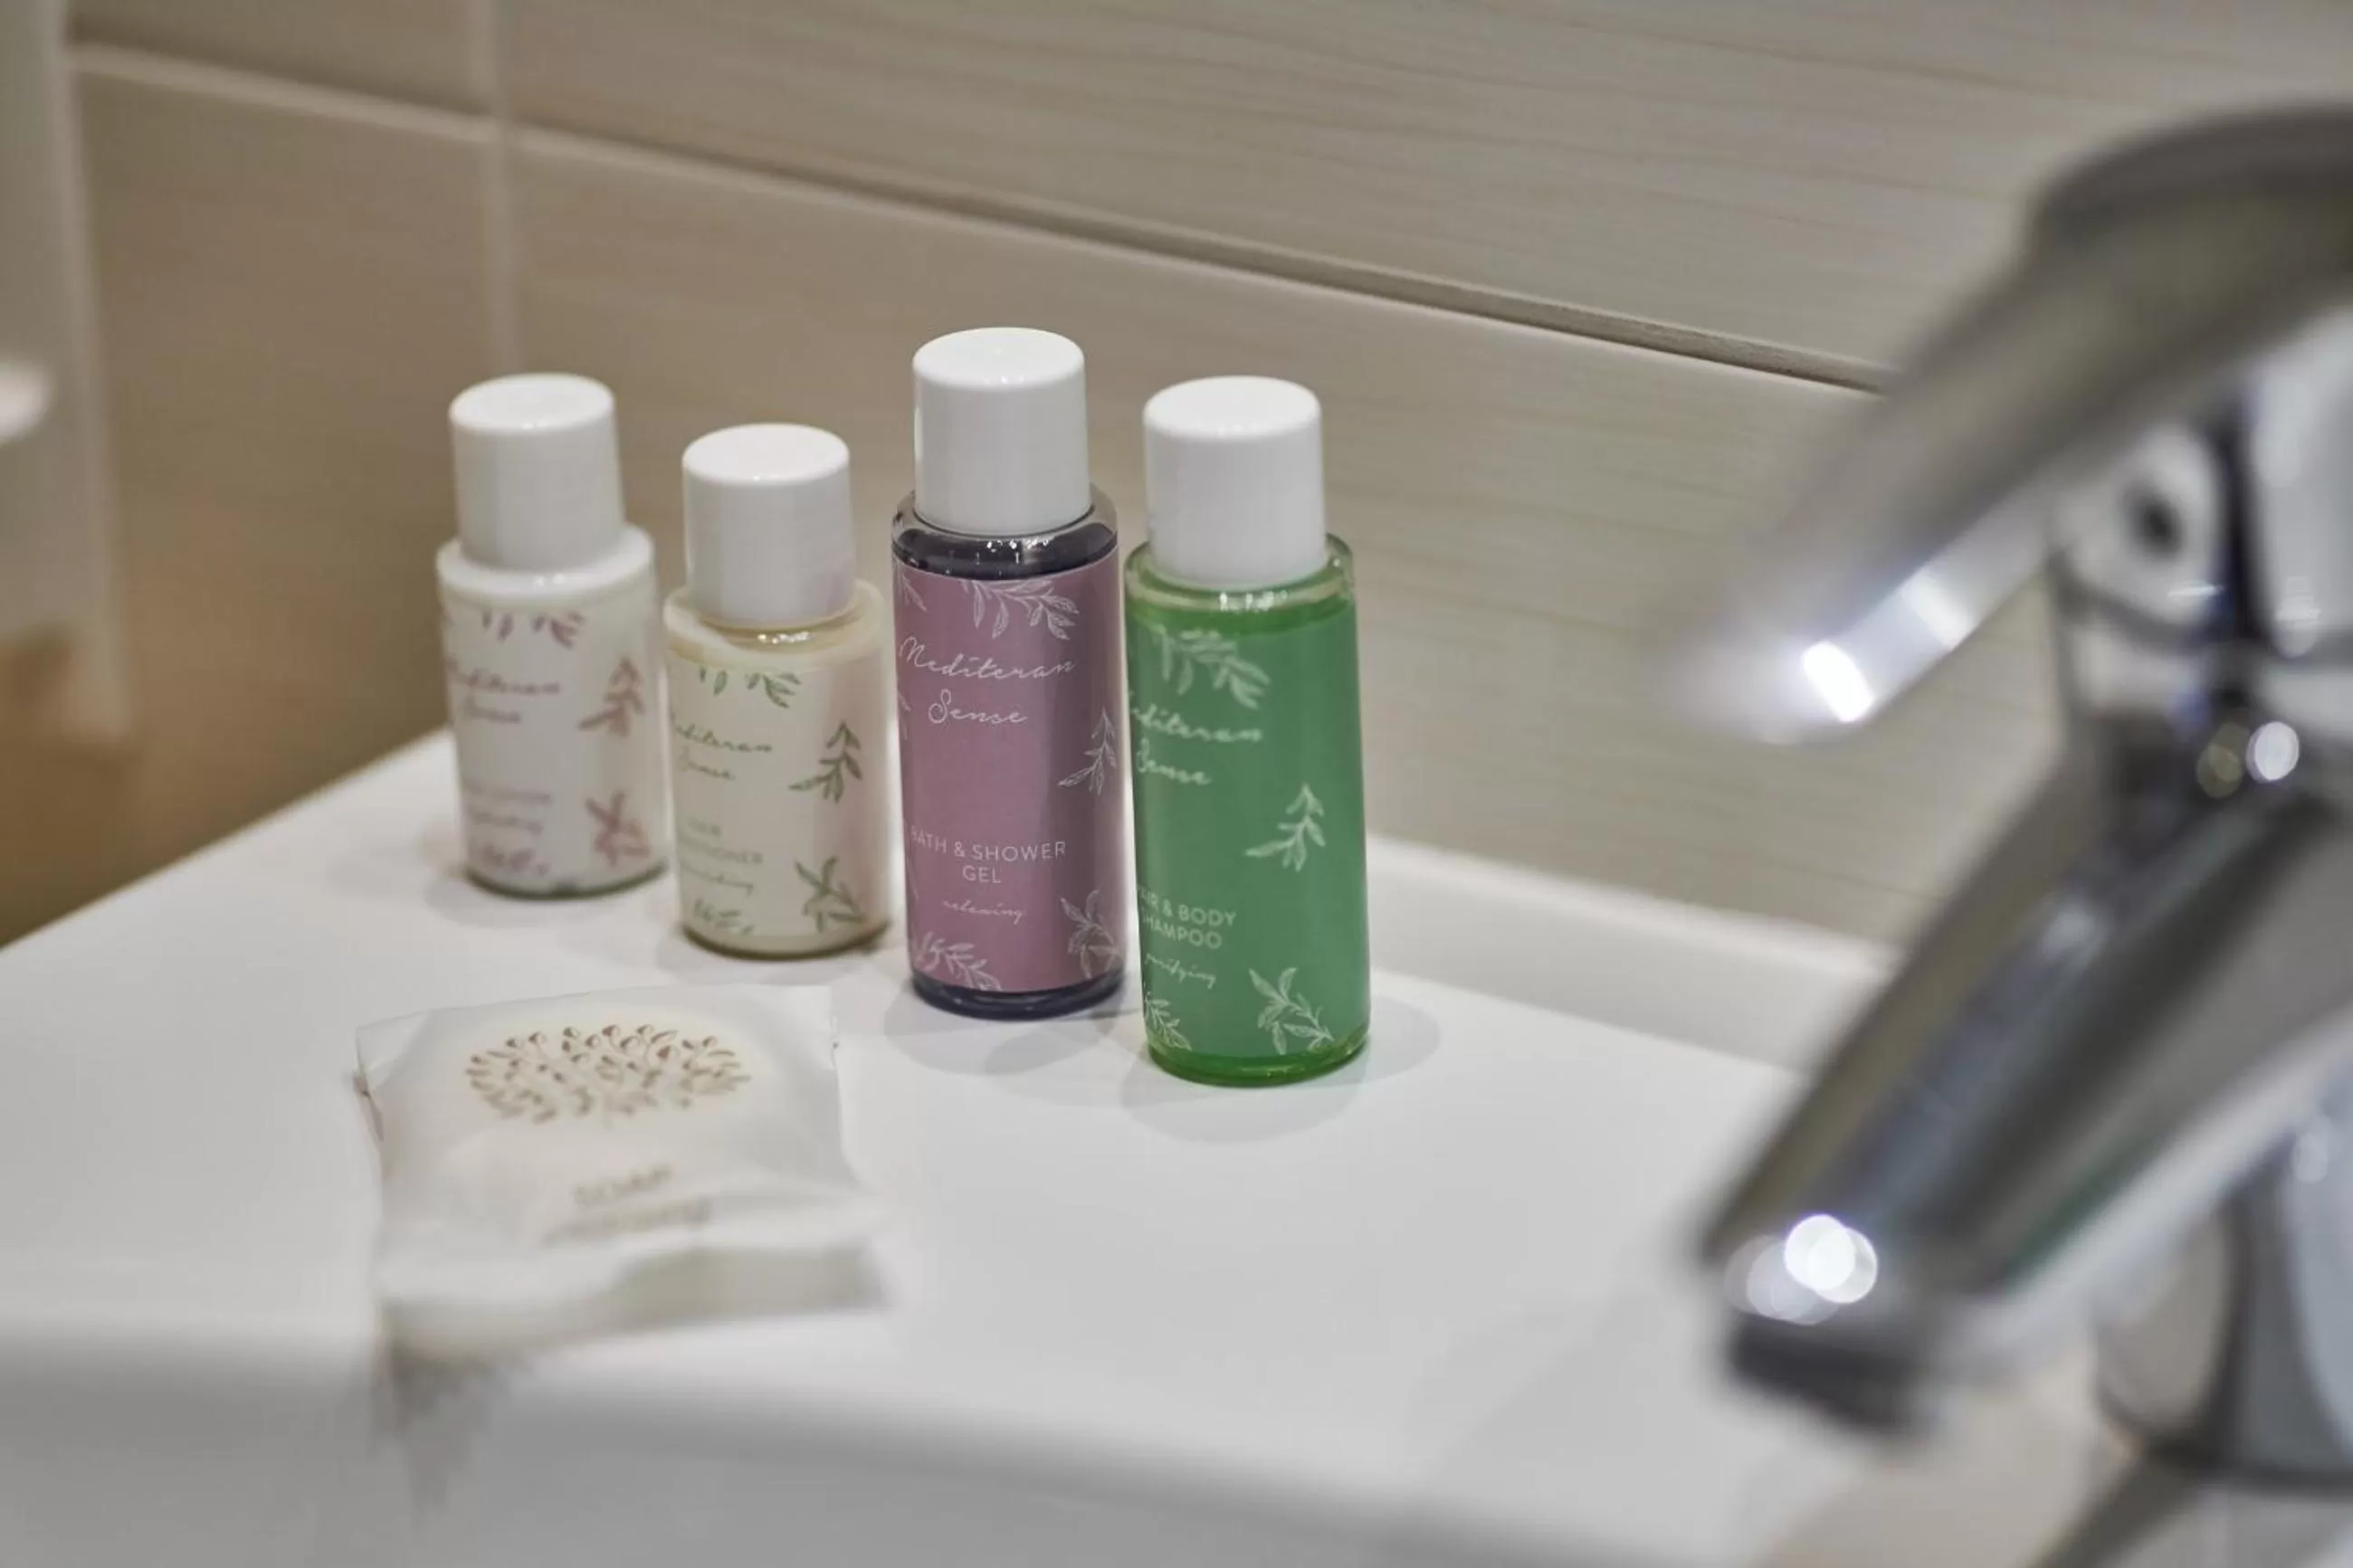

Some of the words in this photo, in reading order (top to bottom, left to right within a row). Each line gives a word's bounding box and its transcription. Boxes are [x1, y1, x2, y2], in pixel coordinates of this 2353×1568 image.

[898, 635, 1076, 679] Mediteran
[928, 689, 1028, 724] Sense
[954, 841, 966, 858] &
[971, 841, 1067, 862] SHOWER
[962, 864, 1003, 884] GEL
[1161, 898, 1173, 917] &
[1177, 903, 1237, 927] BODY
